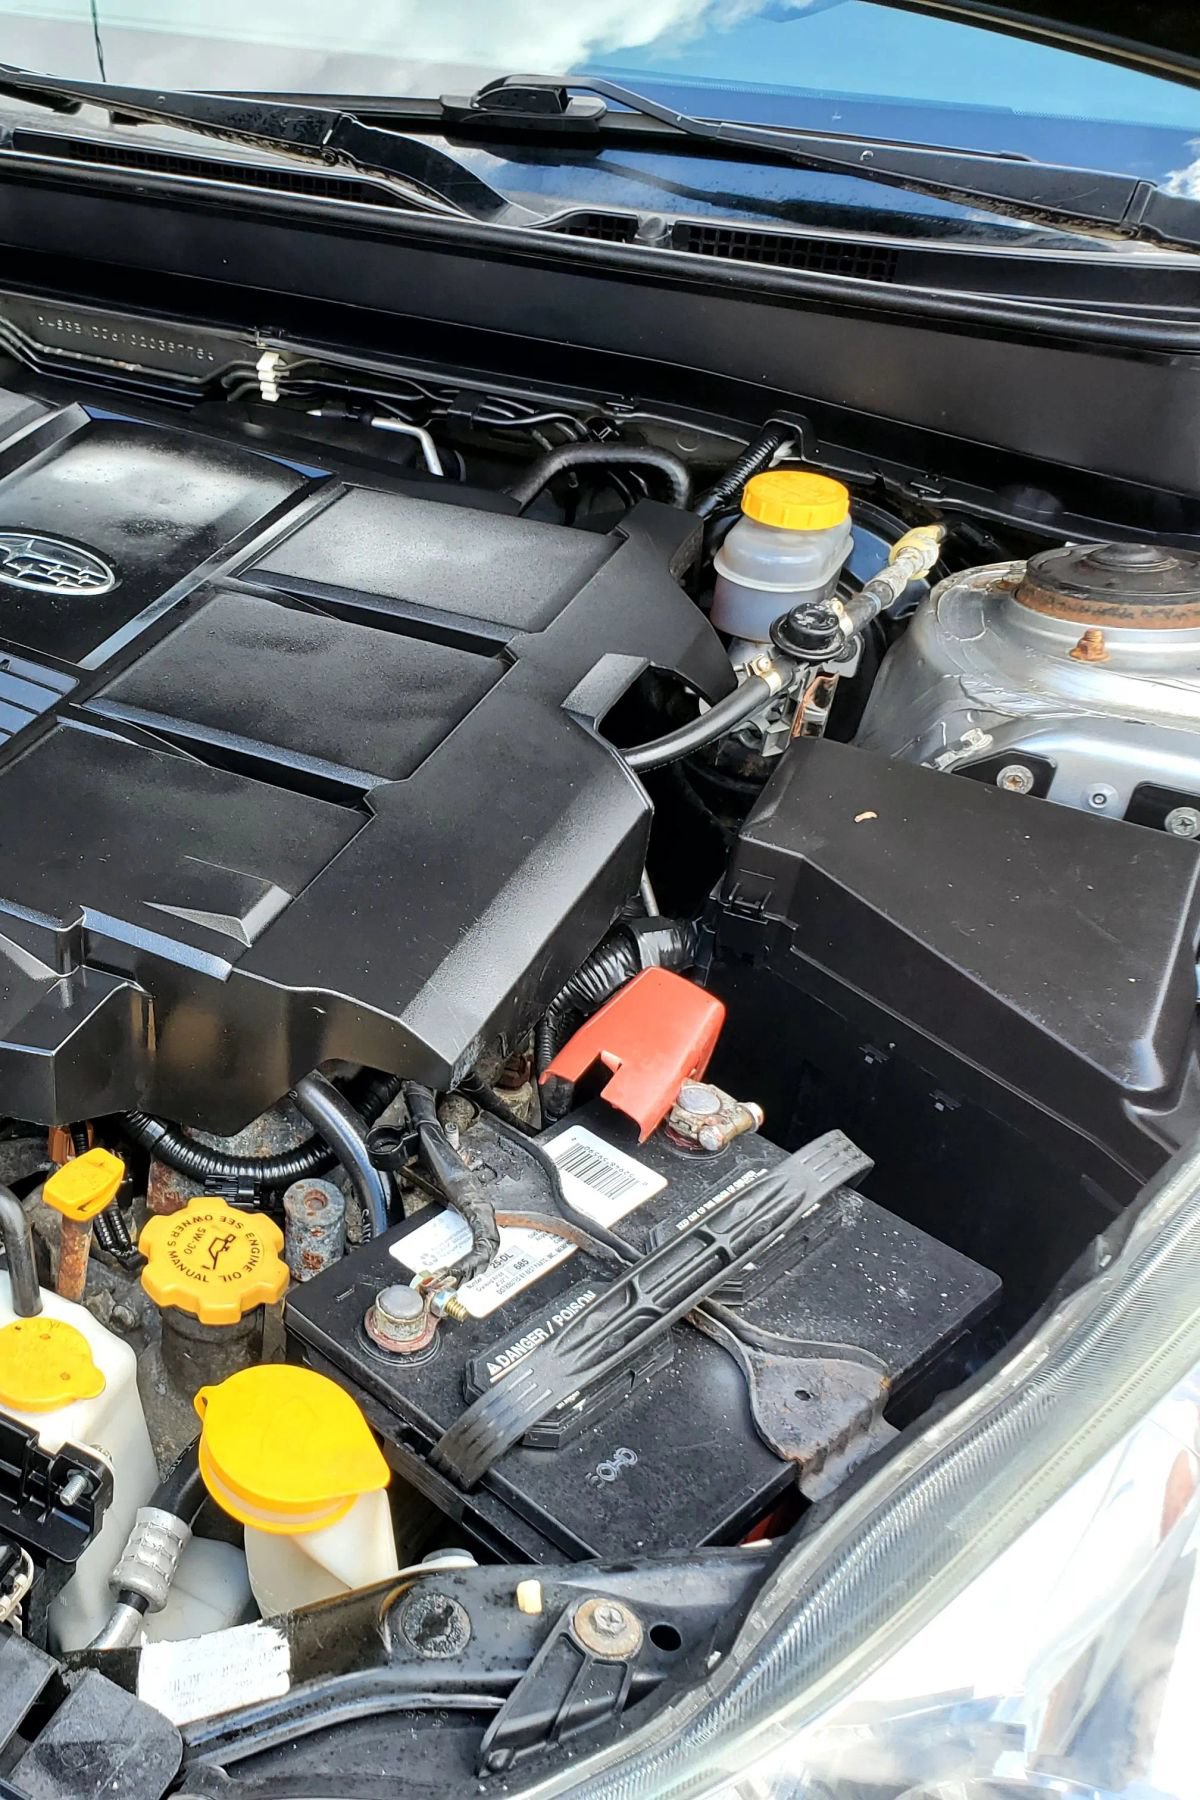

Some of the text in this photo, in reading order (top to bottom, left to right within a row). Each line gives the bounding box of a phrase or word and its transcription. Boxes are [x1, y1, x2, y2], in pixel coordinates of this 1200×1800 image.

[219, 1215, 244, 1230] SEE
[184, 1227, 206, 1255] 5W-30
[168, 1250, 210, 1283] MANUAL
[218, 1232, 261, 1283] ENGINE OIL
[513, 1258, 529, 1271] 685
[495, 1328, 549, 1366] DANGER
[552, 1290, 597, 1327] POISON
